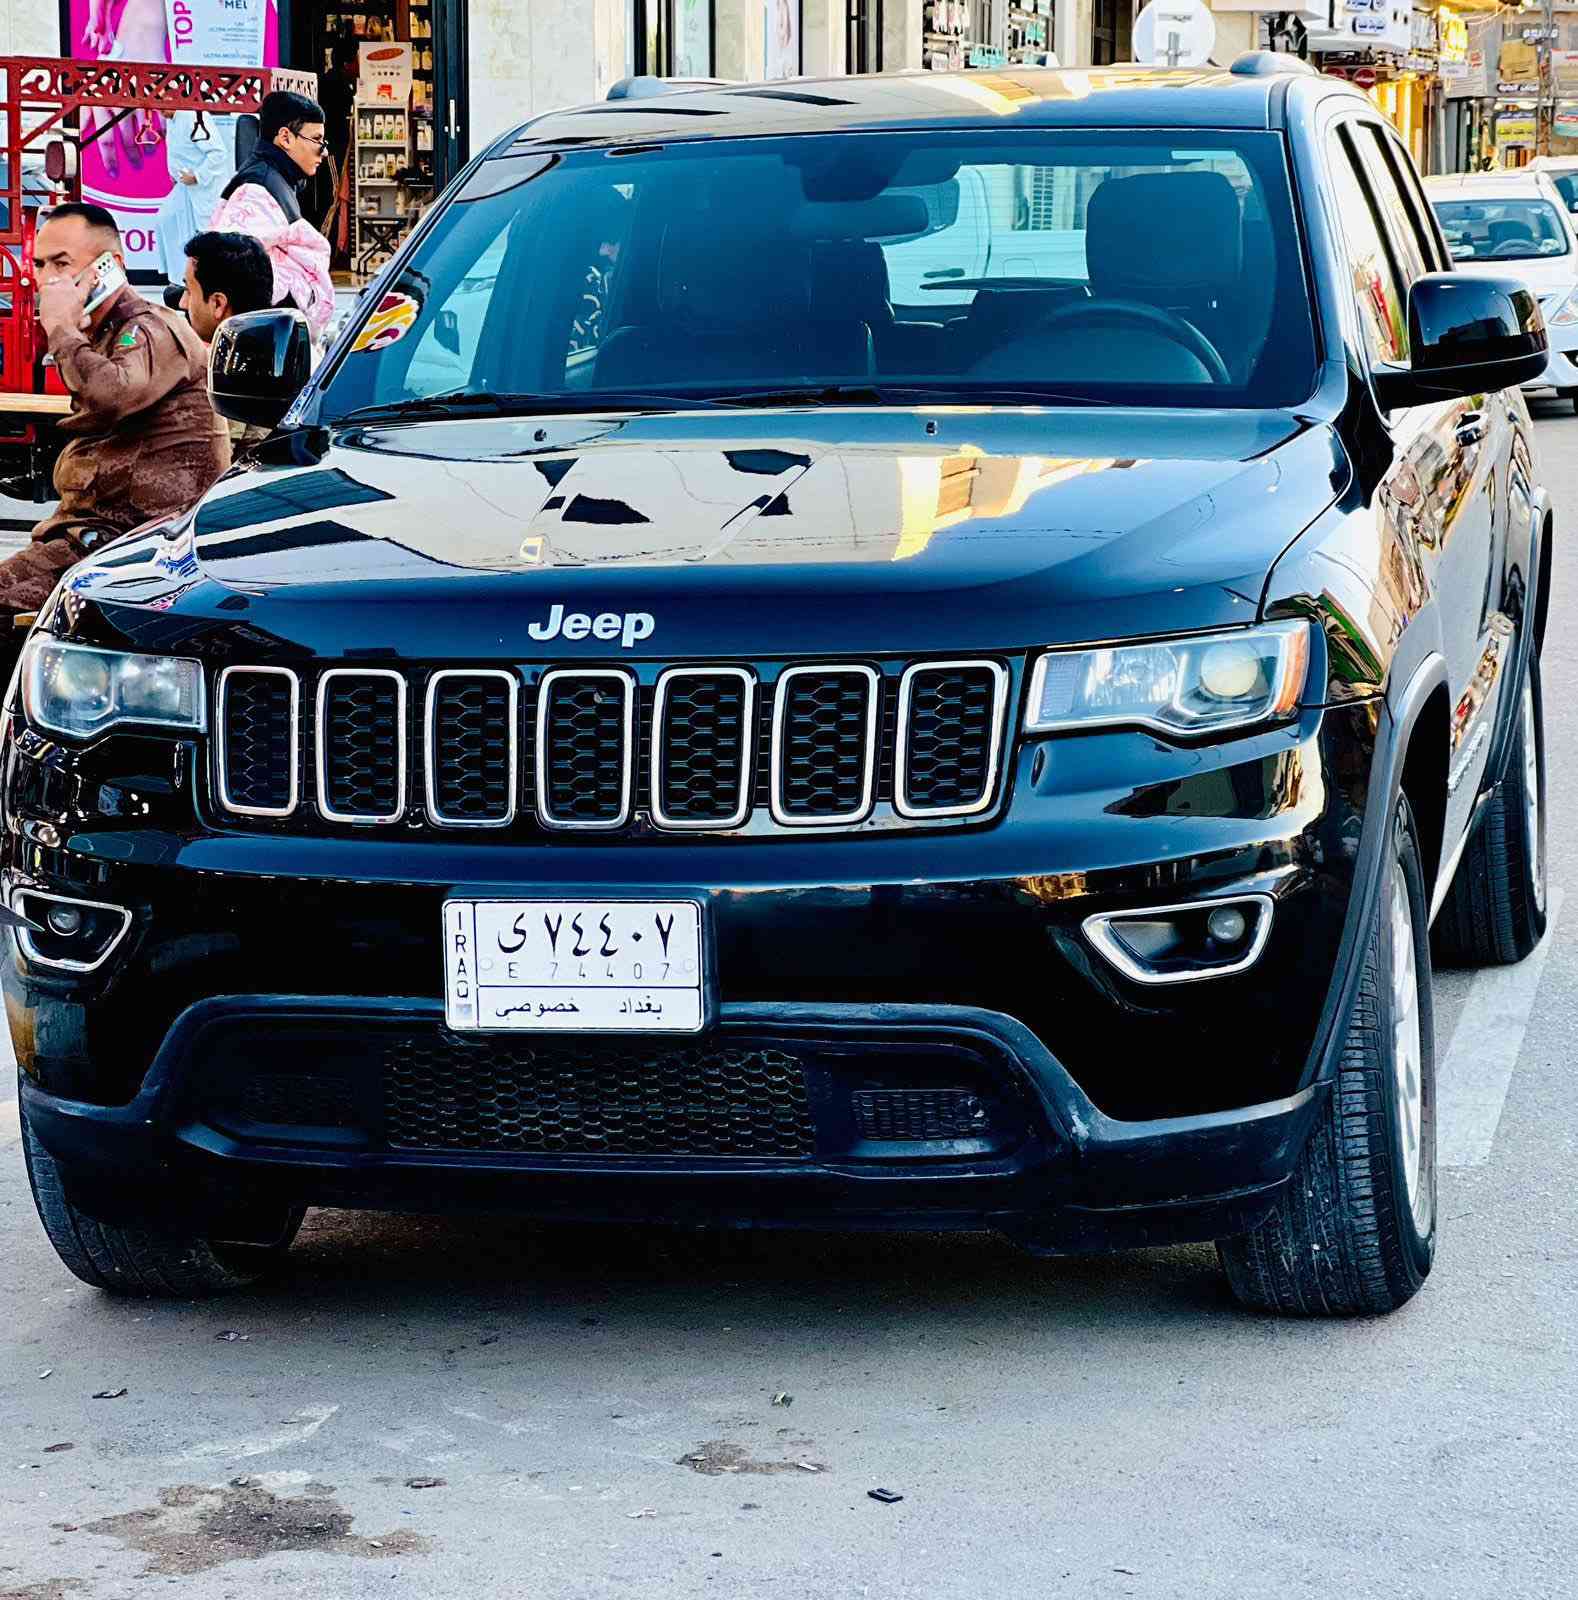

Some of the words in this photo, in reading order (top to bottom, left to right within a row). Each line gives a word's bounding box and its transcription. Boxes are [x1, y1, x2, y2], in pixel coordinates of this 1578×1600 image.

[174, 0, 193, 49] TOP
[528, 604, 656, 648] Jeep
[455, 911, 469, 999] IRAQ
[550, 961, 671, 981] 74407
[618, 994, 664, 1021] بغداد
